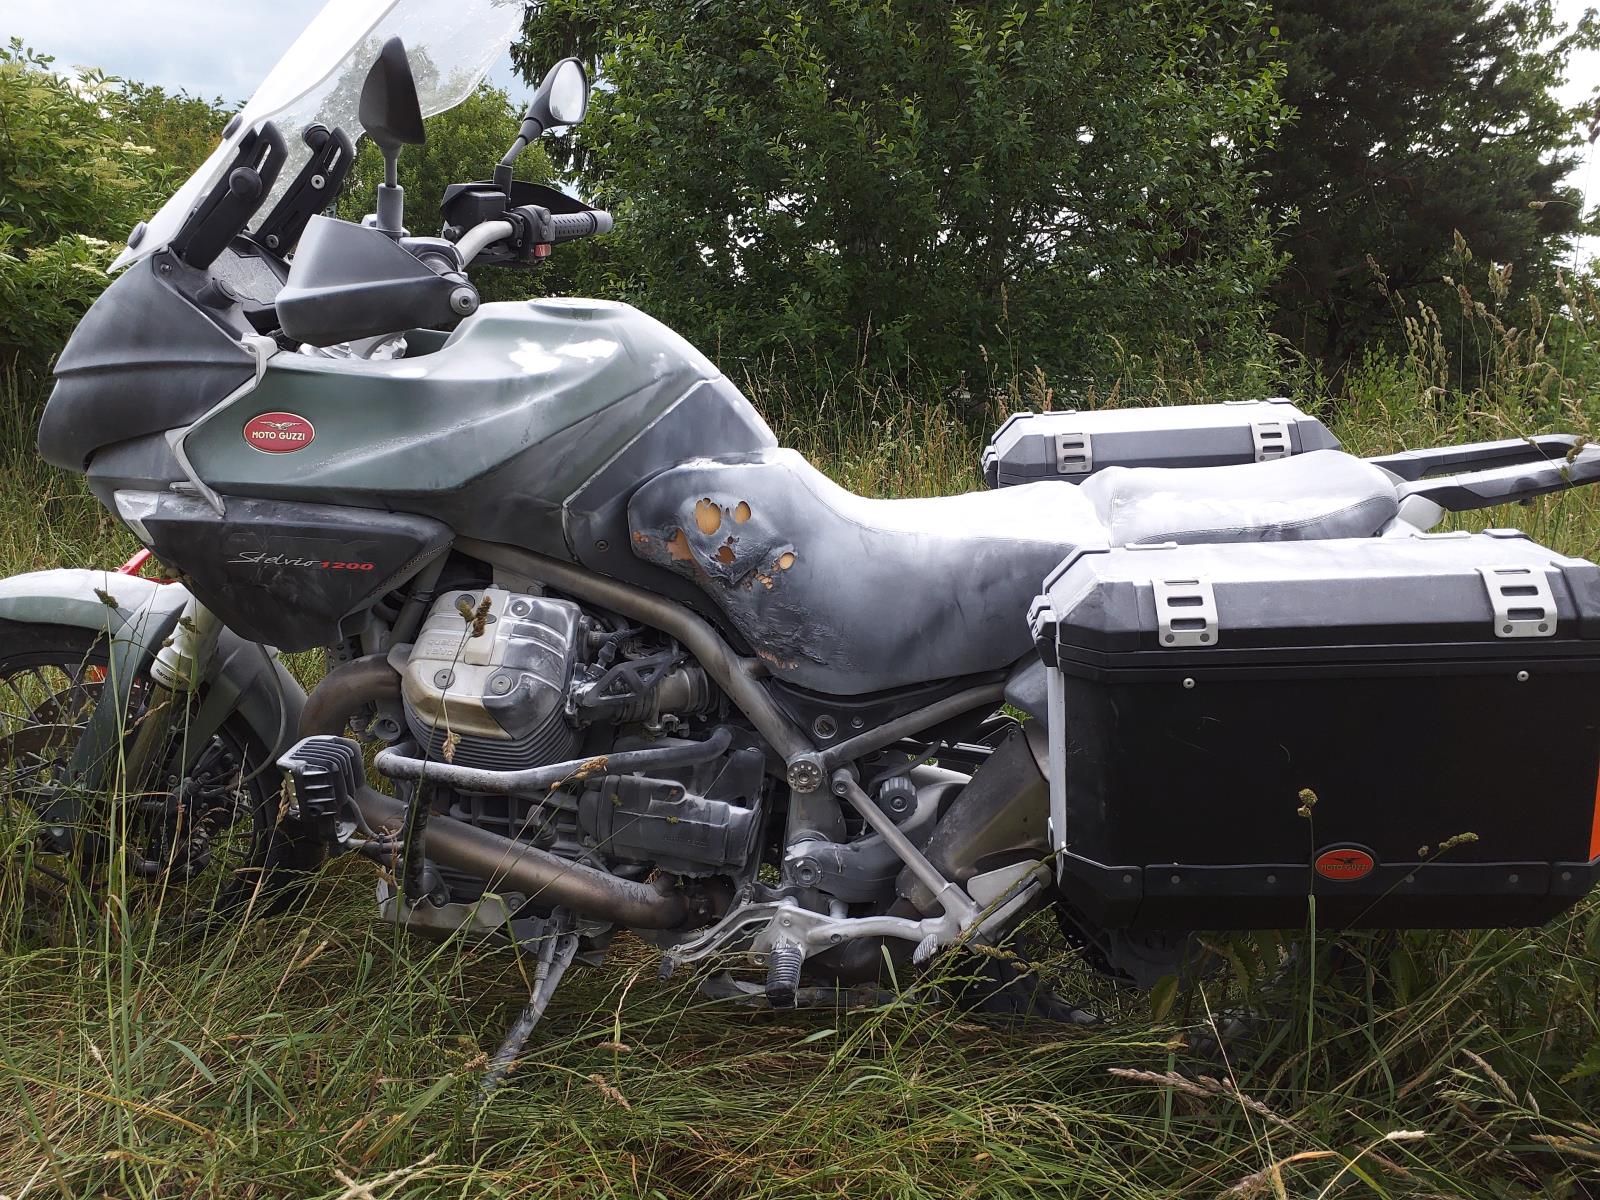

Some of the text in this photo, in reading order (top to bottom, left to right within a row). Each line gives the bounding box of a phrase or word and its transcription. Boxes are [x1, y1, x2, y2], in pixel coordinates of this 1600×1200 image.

[252, 431, 305, 440] MOTO GUZZI
[228, 551, 375, 571] Stelvio 1200
[1321, 863, 1343, 871] MOTO
